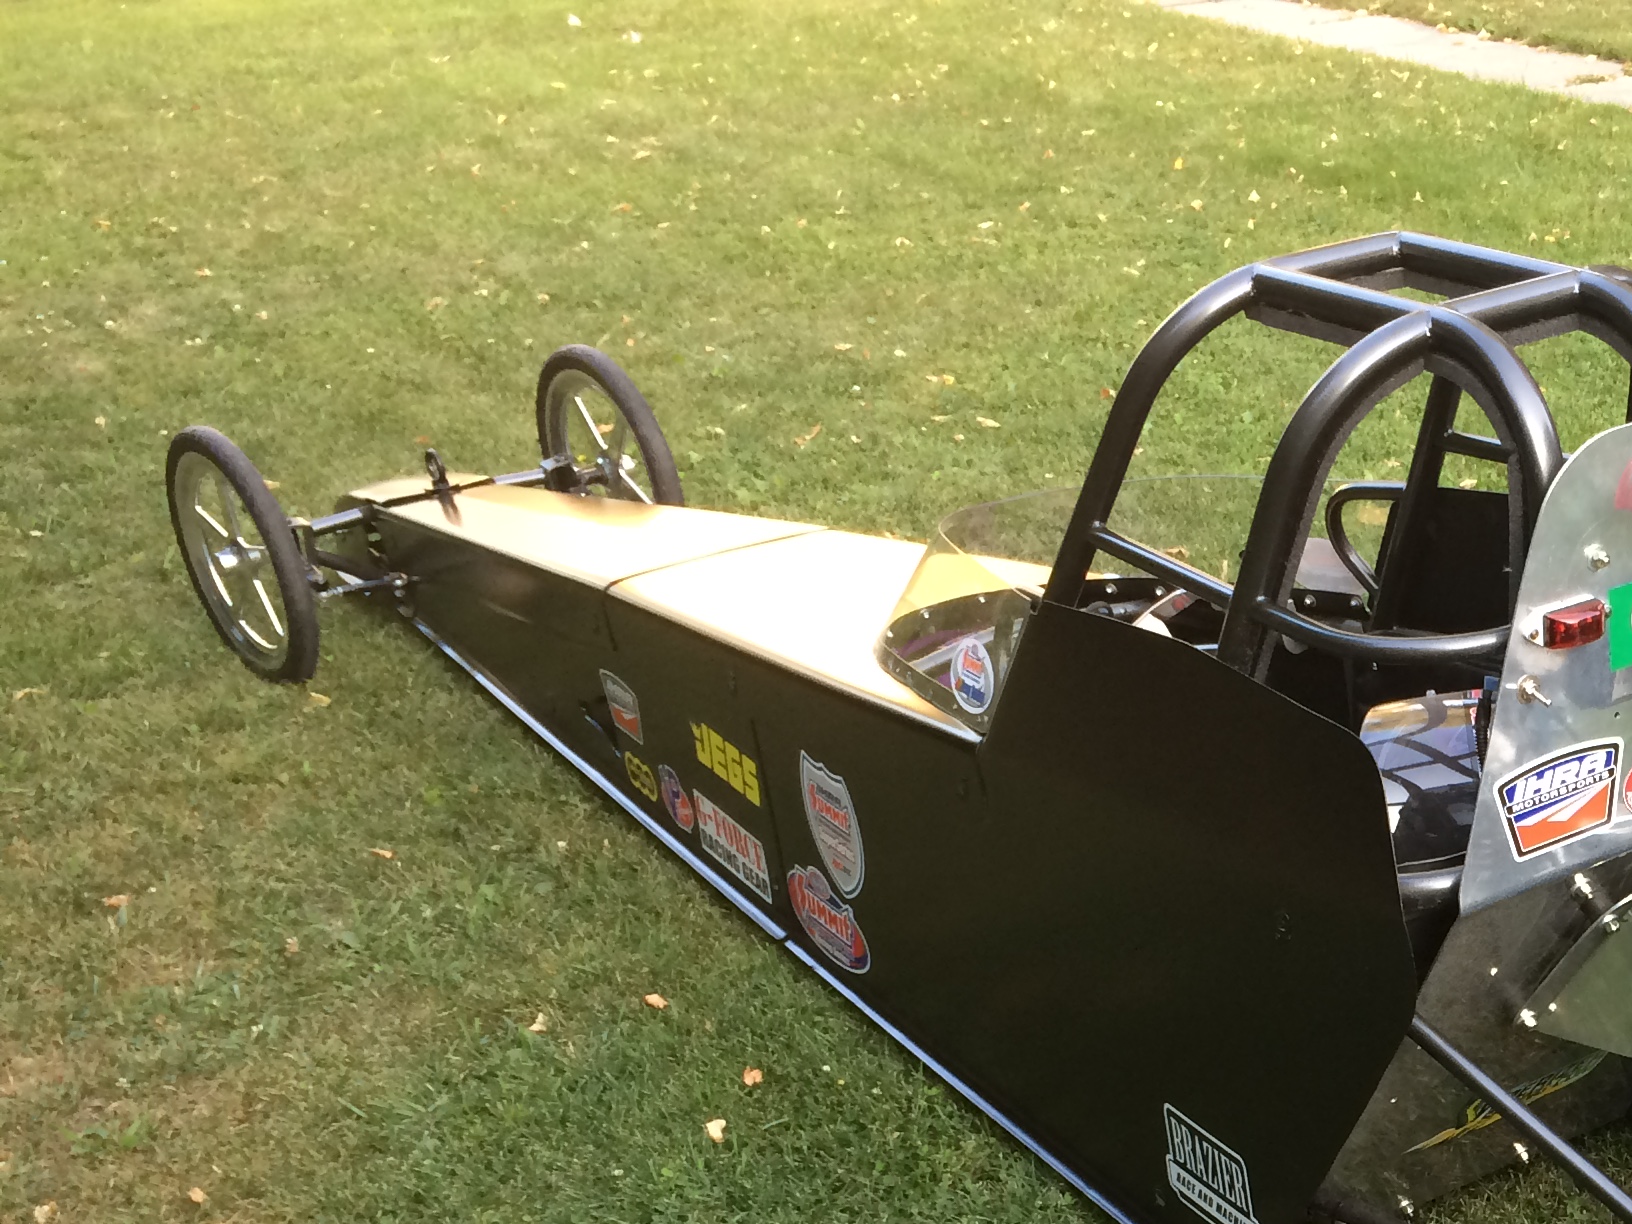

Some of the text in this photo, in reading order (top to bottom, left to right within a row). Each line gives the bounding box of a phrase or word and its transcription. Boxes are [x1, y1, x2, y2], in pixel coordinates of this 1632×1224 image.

[690, 721, 761, 807] JEGS
[1511, 769, 1611, 813] MOTORSPORTS
[1513, 751, 1608, 804] IHRA
[694, 795, 766, 875] G-FORCE
[1169, 1115, 1249, 1213] BRAZIER
[1176, 1172, 1196, 1195] RACE
[1197, 1188, 1214, 1209] AND
